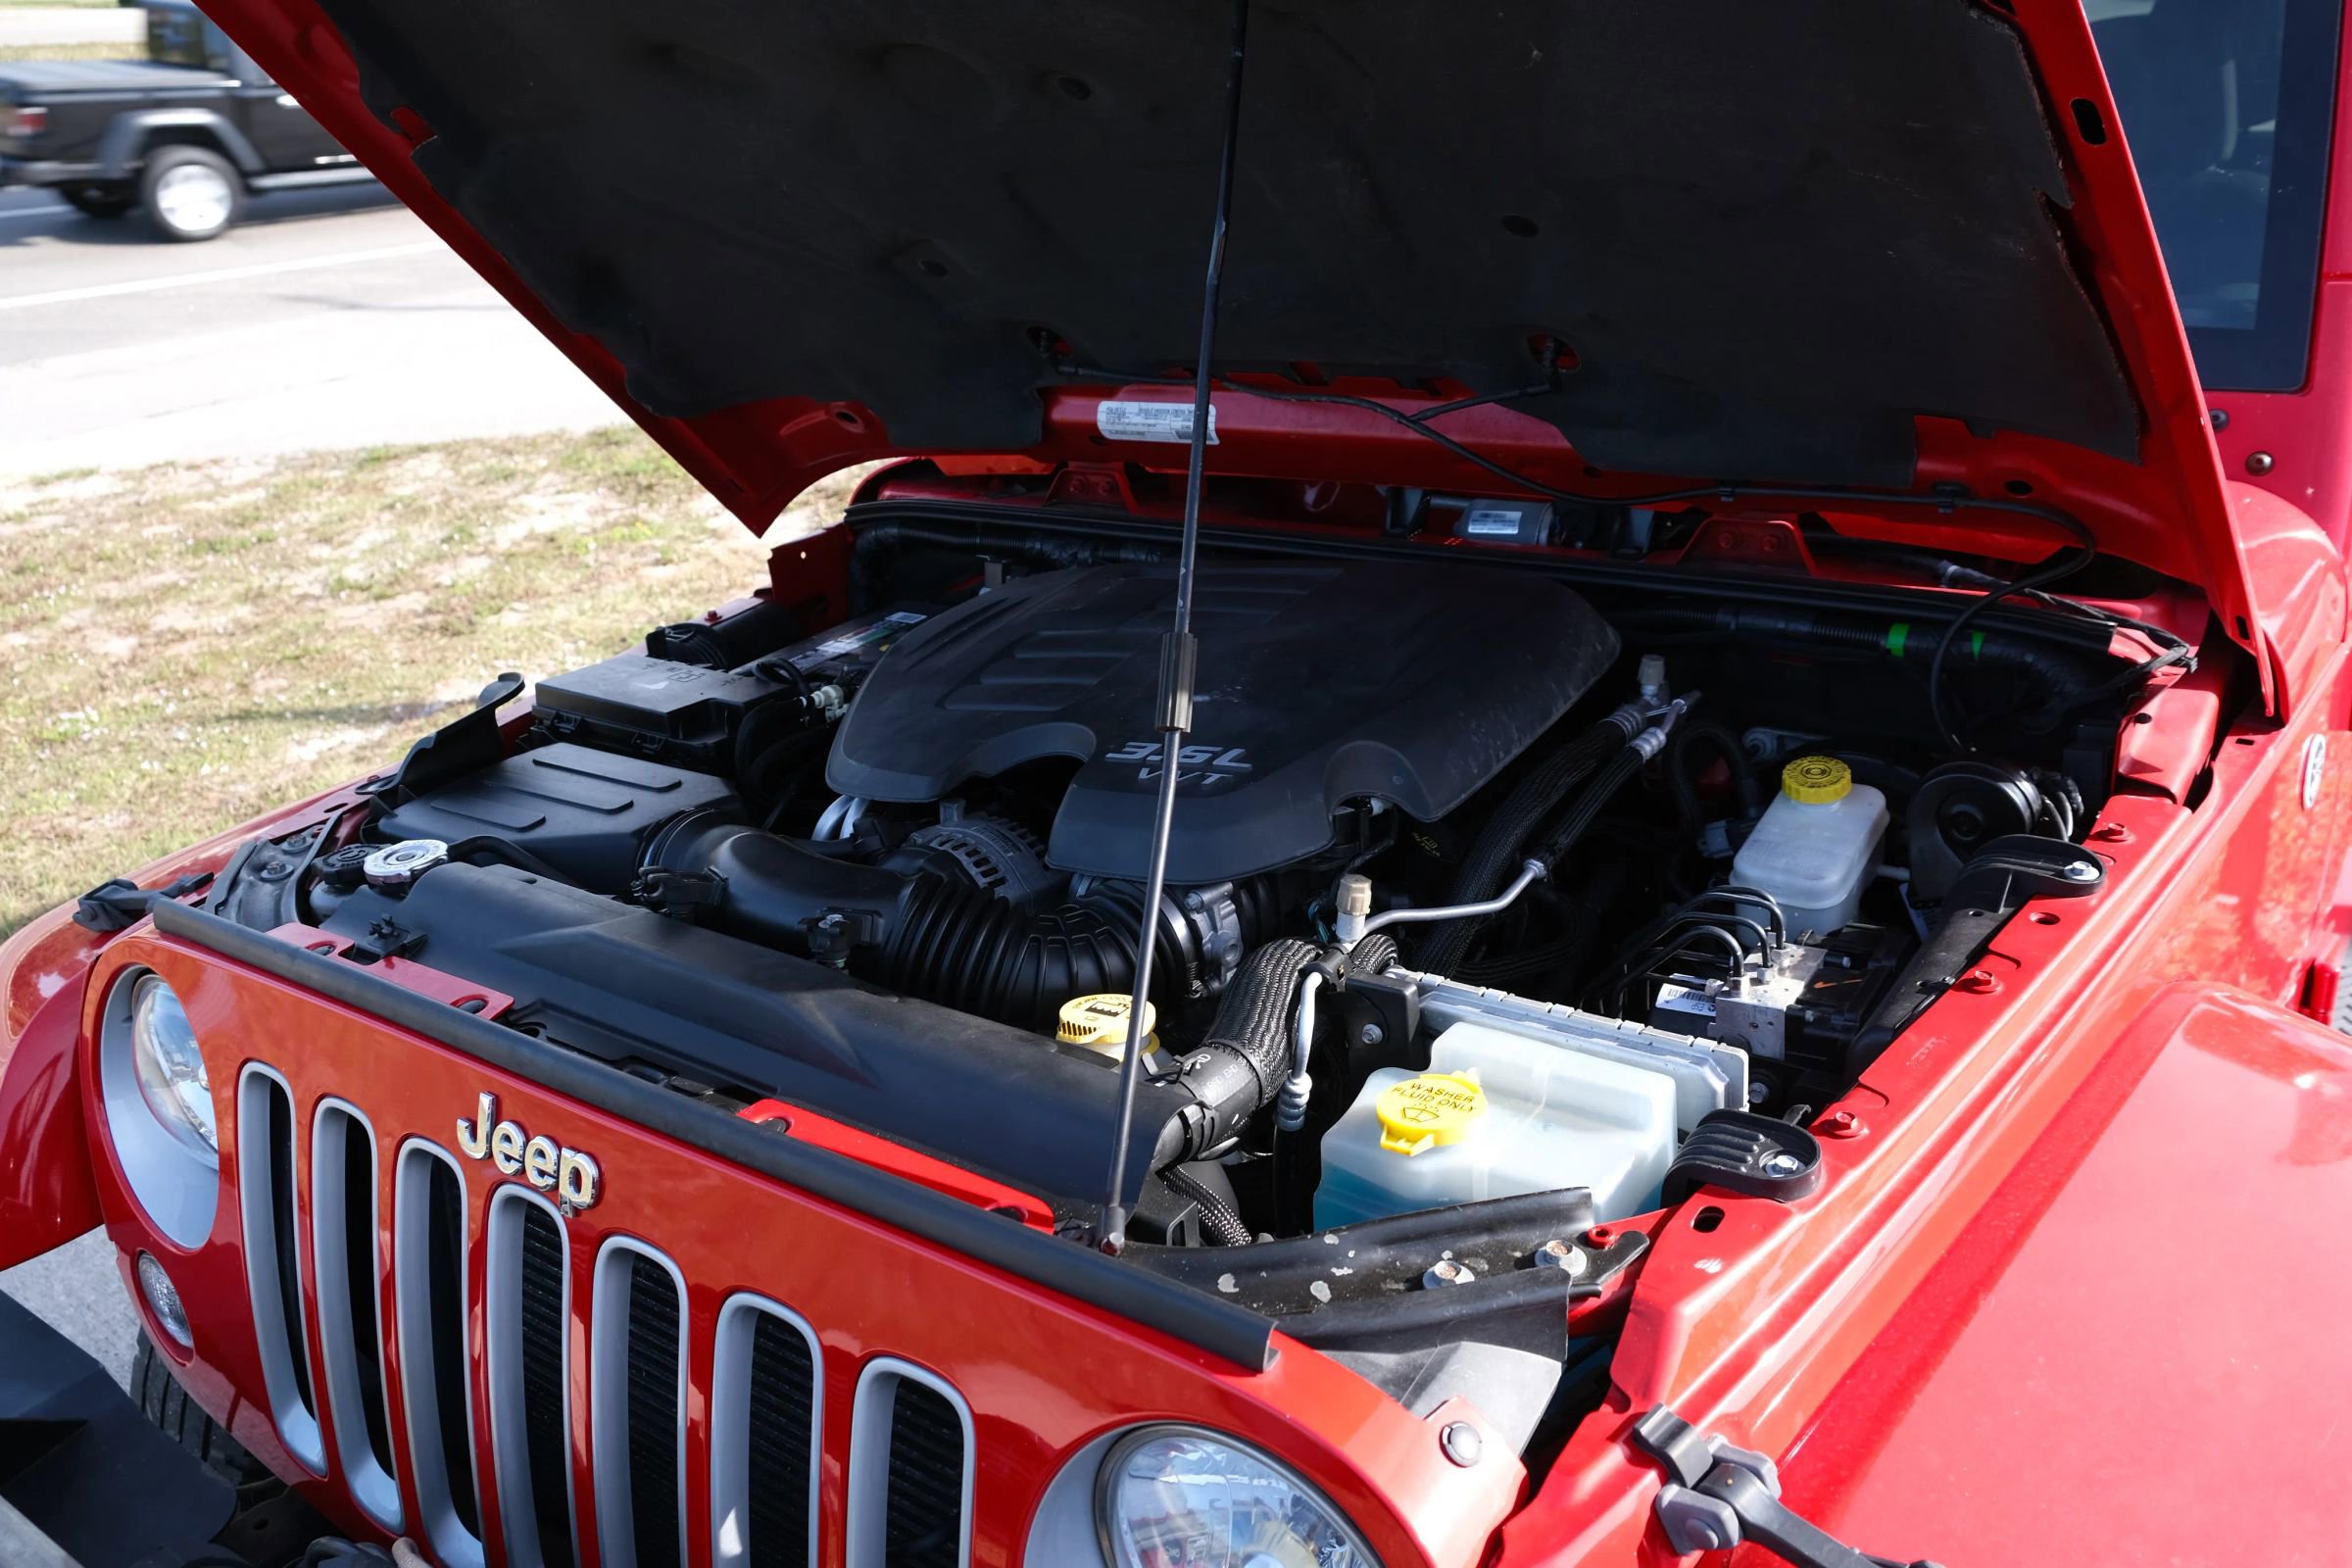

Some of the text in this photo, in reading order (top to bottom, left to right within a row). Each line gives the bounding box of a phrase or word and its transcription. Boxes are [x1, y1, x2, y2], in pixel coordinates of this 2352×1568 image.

[1105, 742, 1252, 769] 3.6L
[1392, 1087, 1477, 1112] FLUID ONLY
[1410, 1083, 1475, 1102] WASHER
[457, 1091, 600, 1218] Jeep
